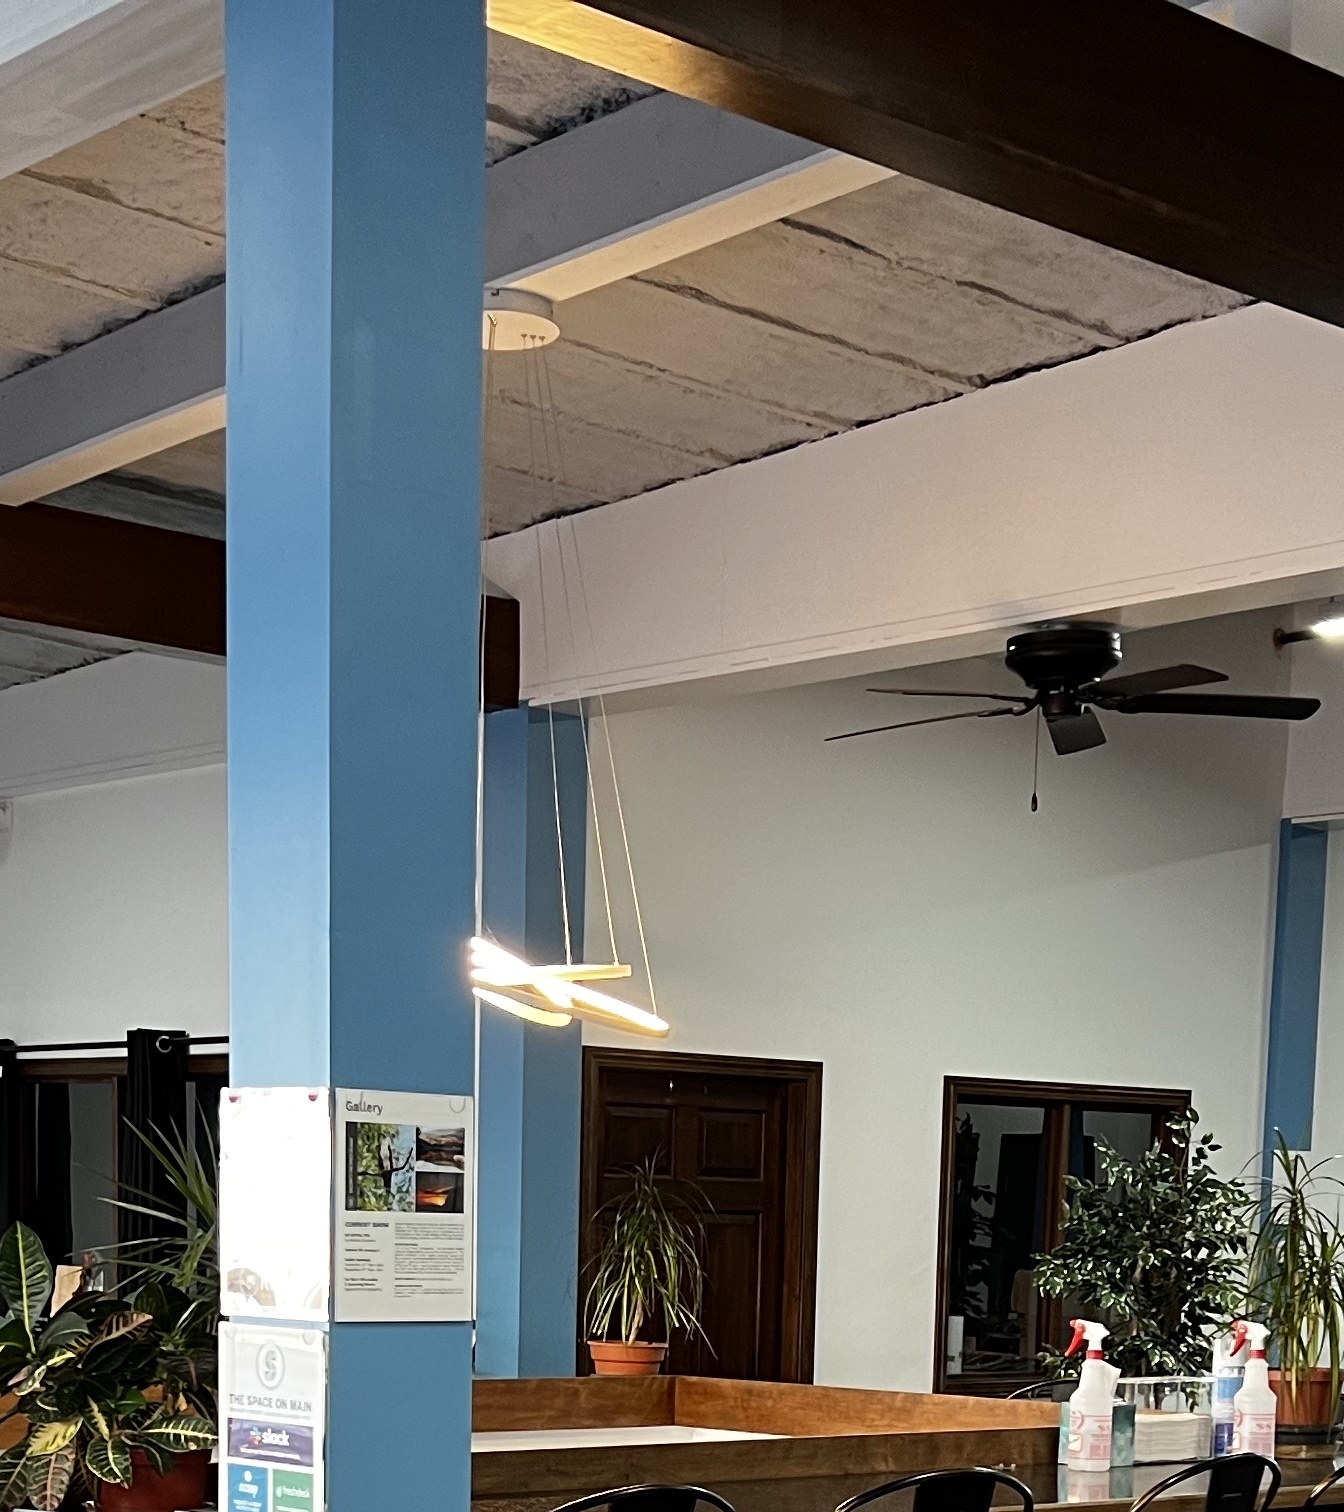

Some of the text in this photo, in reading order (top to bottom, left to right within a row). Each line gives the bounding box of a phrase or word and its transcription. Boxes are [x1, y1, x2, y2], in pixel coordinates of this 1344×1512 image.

[345, 1100, 383, 1116] Gallery
[229, 1393, 312, 1412] THE SPACE ON MAIN
[261, 1427, 290, 1447] slack
